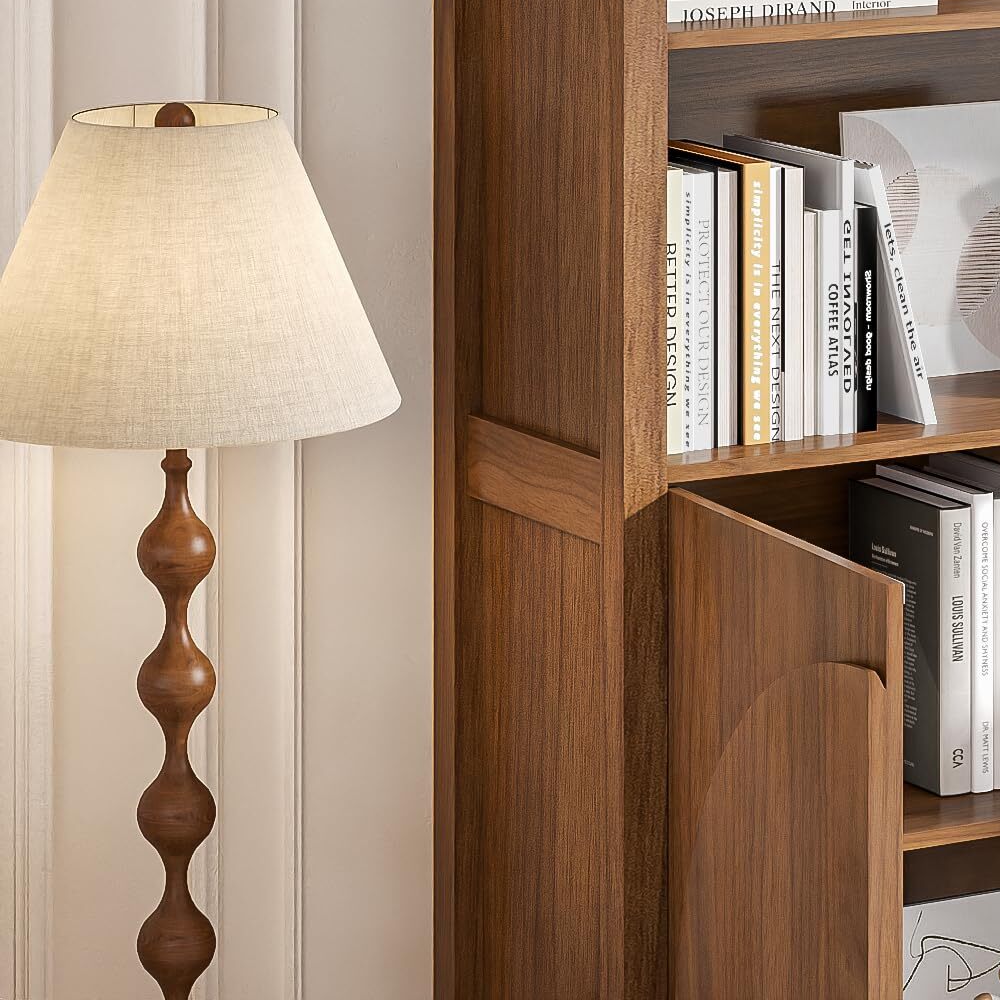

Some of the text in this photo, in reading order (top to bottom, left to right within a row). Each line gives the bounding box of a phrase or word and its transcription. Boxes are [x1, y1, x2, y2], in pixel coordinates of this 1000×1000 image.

[681, 0, 836, 23] JOSEPH DIRAND
[684, 192, 692, 267] simplicity
[685, 273, 692, 285] is
[685, 291, 692, 305] in
[750, 180, 763, 441] simplicity is in everything we see
[884, 223, 924, 380] lets, clean the air
[684, 312, 692, 392] everything
[698, 219, 710, 426] PROTECT OUR DESIGN
[771, 260, 781, 441] THE NEXT DESIGN
[828, 283, 839, 377] COFFEE ATLAS
[953, 522, 963, 541] David
[953, 541, 963, 555] Van
[952, 595, 964, 663] LOUIS SULLIVAN
[981, 521, 989, 677] OVERCOME SOCIAL ANXIETY AND SHYNESS
[952, 748, 964, 769] CCA
